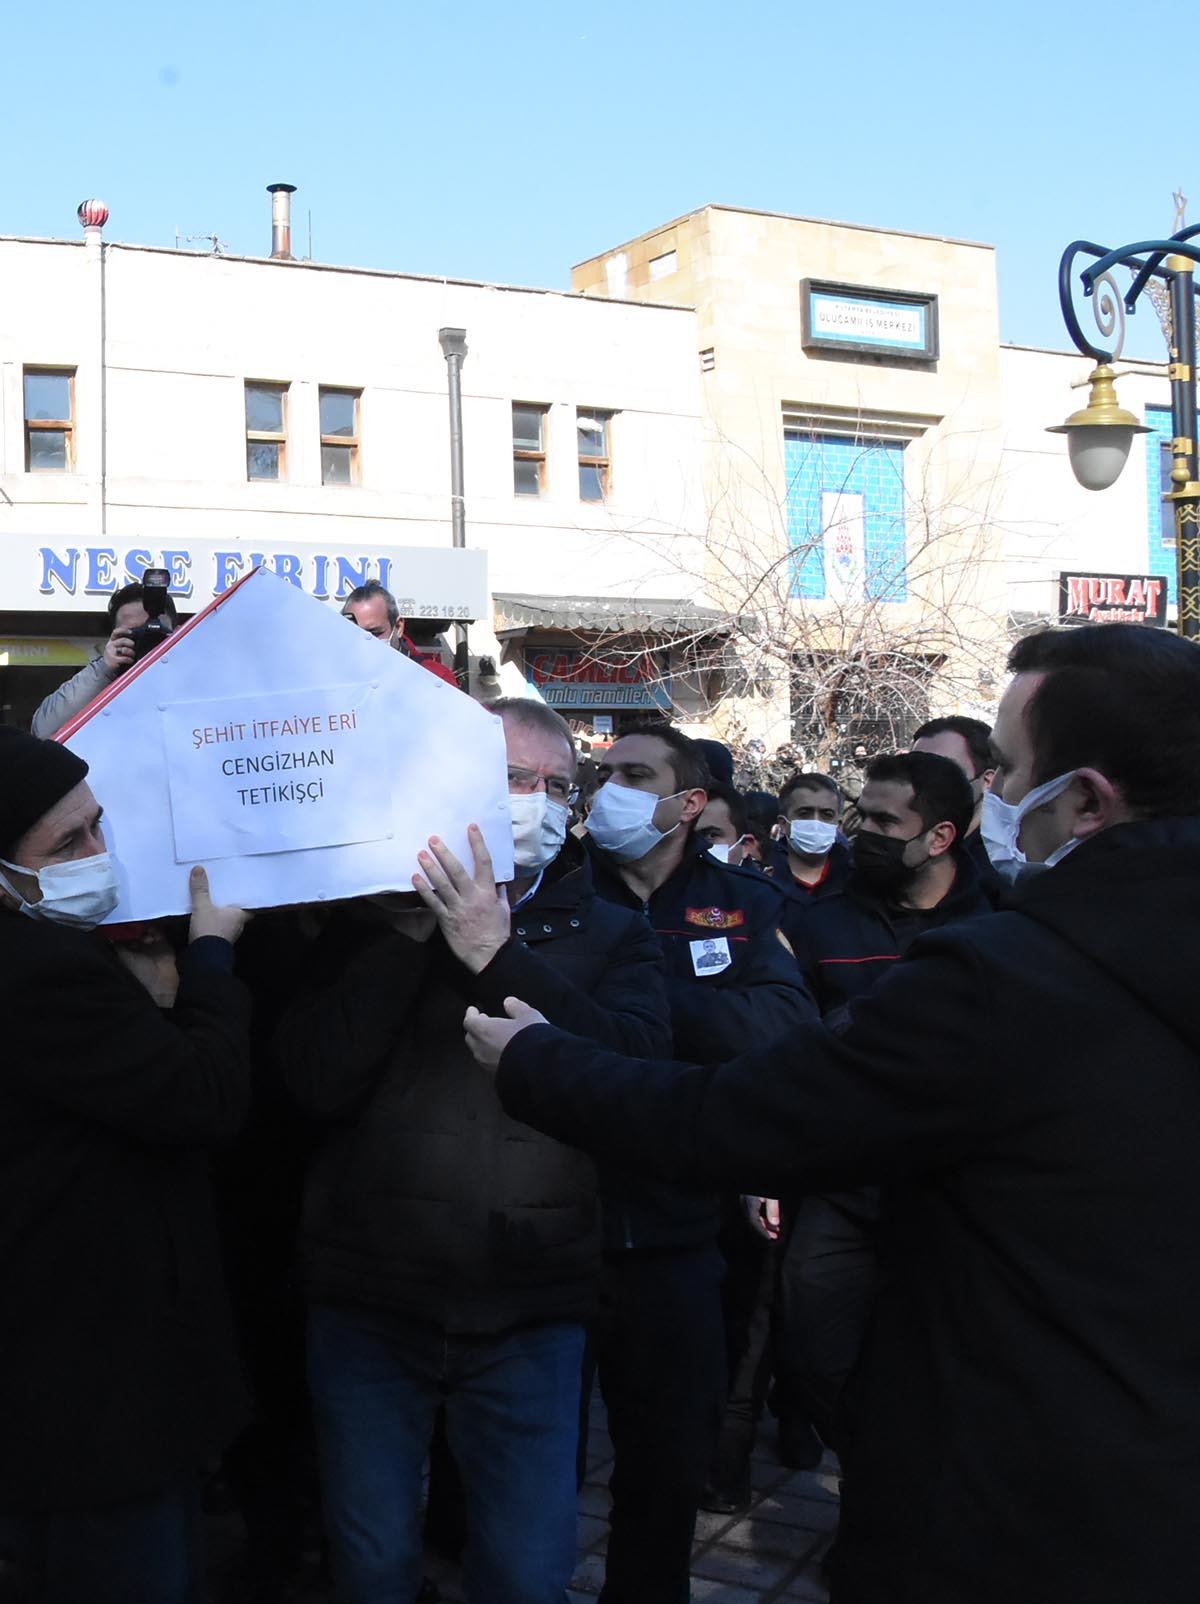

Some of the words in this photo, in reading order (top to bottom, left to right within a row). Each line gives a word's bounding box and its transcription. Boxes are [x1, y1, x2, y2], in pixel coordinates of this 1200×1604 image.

[1066, 577, 1163, 618] MURAT
[545, 687, 577, 704] unlu
[192, 721, 246, 749] ŞEHİT
[252, 715, 321, 740] İTFAİYE
[328, 709, 357, 732] ERİ
[221, 748, 335, 776] CENGİZHAN
[237, 777, 325, 806] TETİKİŞÇİ
